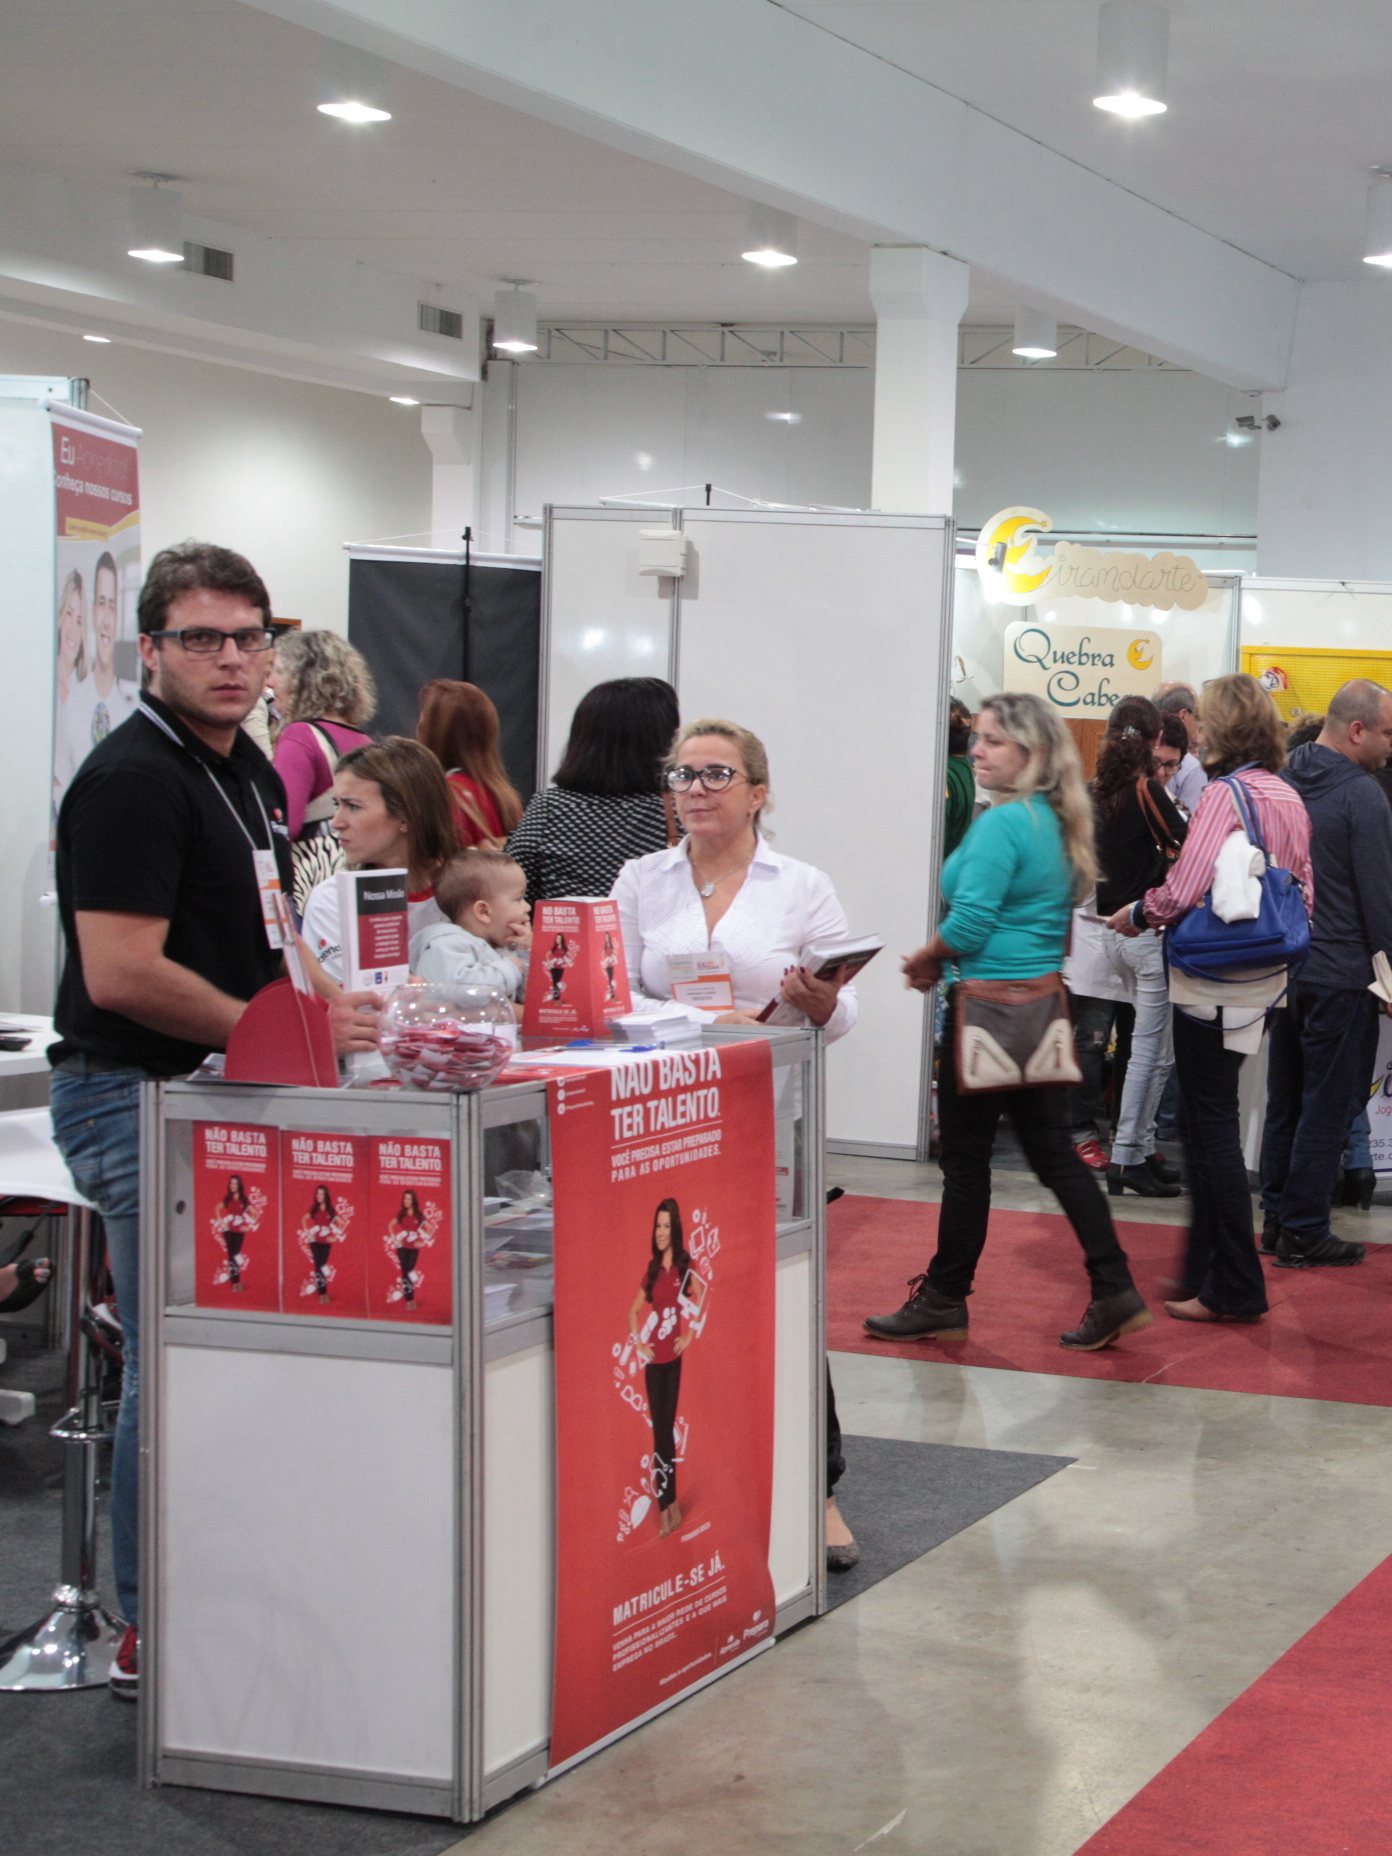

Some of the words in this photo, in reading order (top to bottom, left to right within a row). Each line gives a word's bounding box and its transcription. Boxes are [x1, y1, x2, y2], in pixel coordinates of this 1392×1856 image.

[61, 436, 76, 465] Eu
[55, 472, 83, 496] onheça
[1013, 628, 1116, 671] Quebra
[1047, 670, 1146, 707] Cabe
[659, 1047, 722, 1091] BASTA
[610, 1103, 644, 1141] TER
[646, 1086, 721, 1132] TALENTO.
[205, 1127, 227, 1142] NÃO
[231, 1130, 267, 1144] BASTA
[205, 1141, 224, 1154] TER
[292, 1137, 314, 1152] NÃO
[317, 1140, 353, 1154] BASTA
[379, 1141, 401, 1156] NÃO
[404, 1144, 441, 1158] BASTA
[611, 1148, 630, 1168] VOCÊ
[631, 1144, 660, 1163] PRECISA
[661, 1138, 682, 1155] ESTAR
[683, 1128, 722, 1149] PREPARADO
[292, 1151, 310, 1164] TER
[379, 1155, 398, 1169] TER
[611, 1165, 636, 1183] PARA
[639, 1161, 650, 1175] AS
[652, 1143, 722, 1171] OPORTUNIDADES.
[612, 1563, 705, 1626] MATRICULE-SE
[708, 1549, 726, 1577] JÁ.
